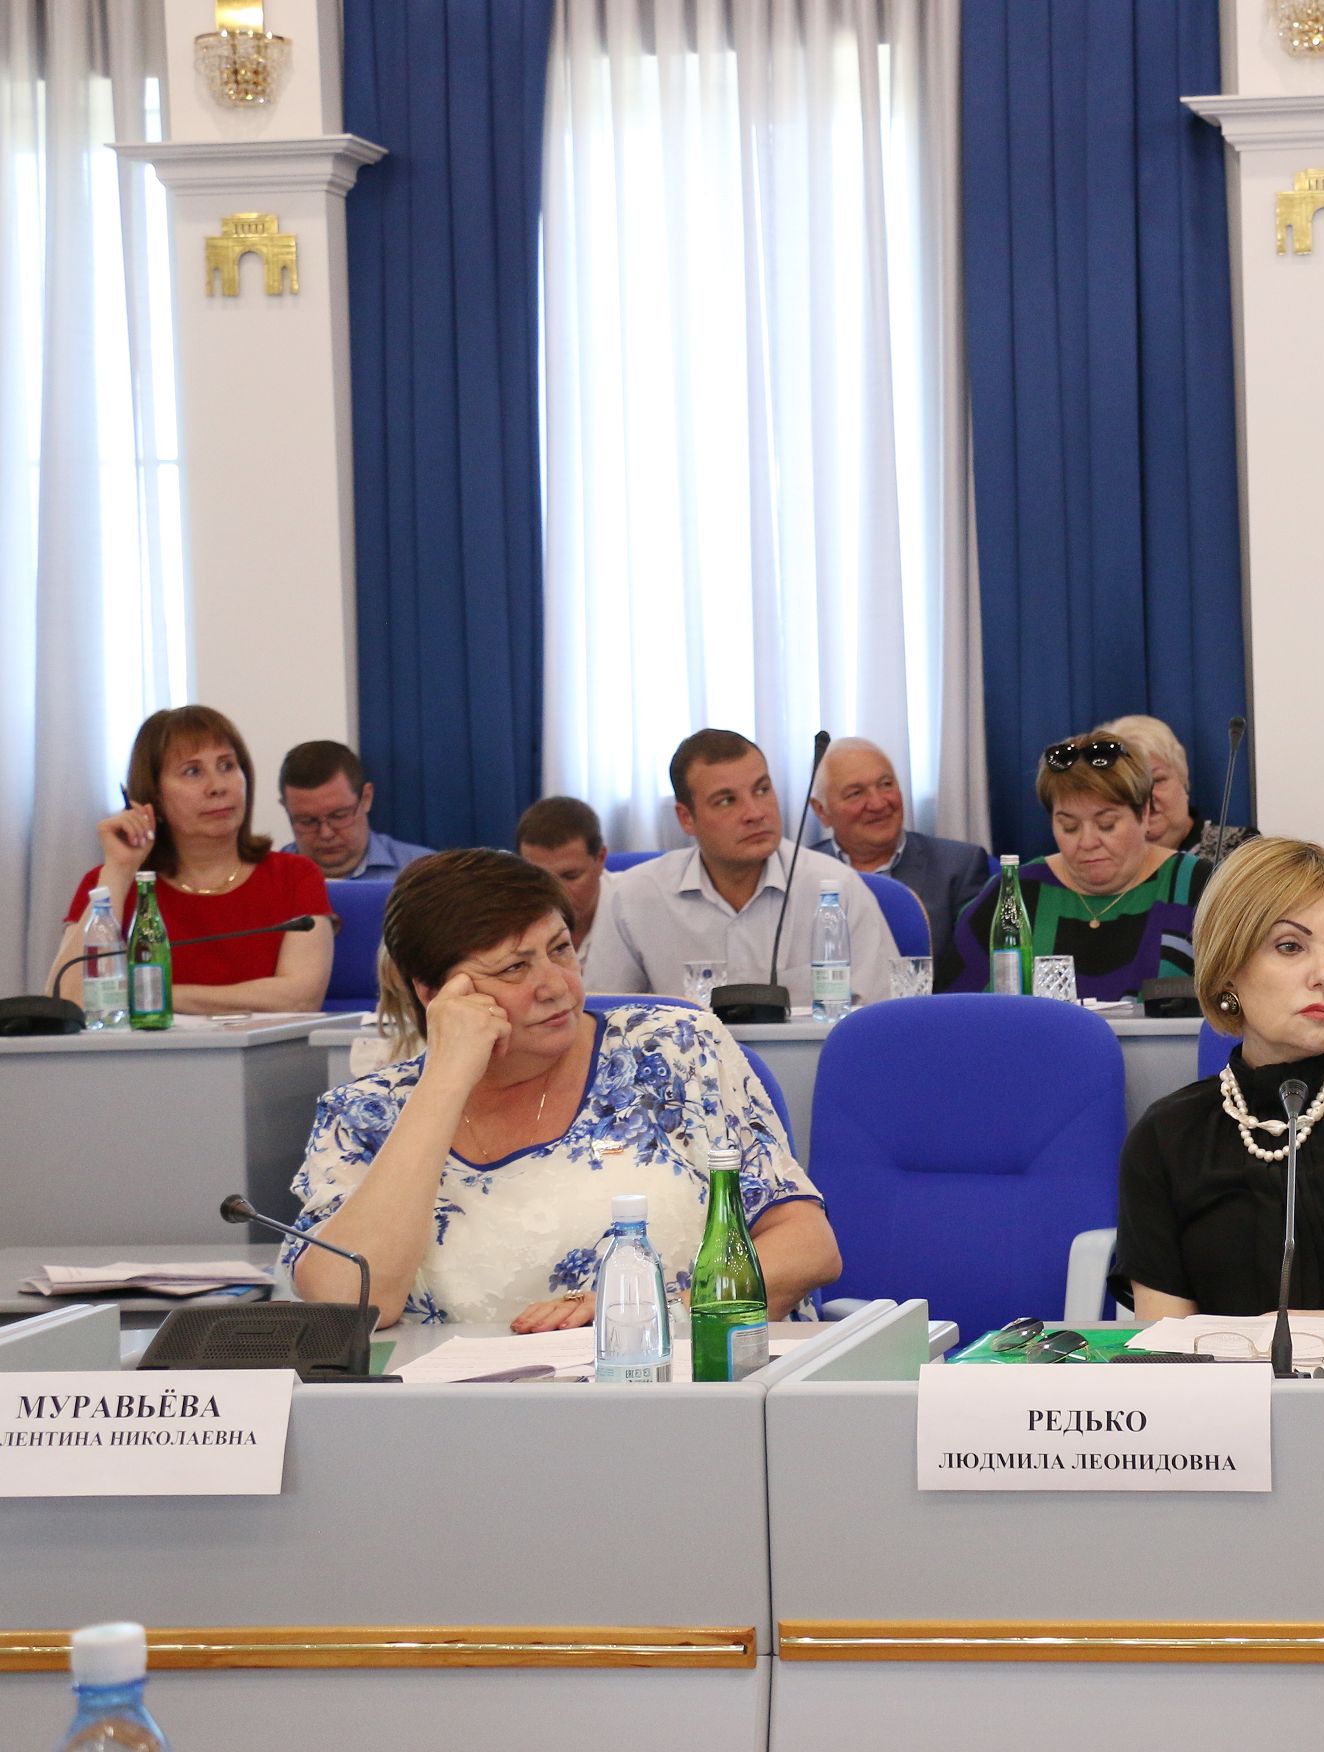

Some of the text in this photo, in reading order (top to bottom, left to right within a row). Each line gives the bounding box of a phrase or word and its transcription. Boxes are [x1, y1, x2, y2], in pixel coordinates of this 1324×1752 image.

[16, 1388, 221, 1419] МУРАВЬЁВА
[1027, 1409, 1147, 1436] РЕДЬКО
[0, 1430, 257, 1447] ЛЕНТИНА НИКОЛАЕВНА
[938, 1452, 1237, 1474] ЛЮДМИЛА ЛЕОНИДОВНА
